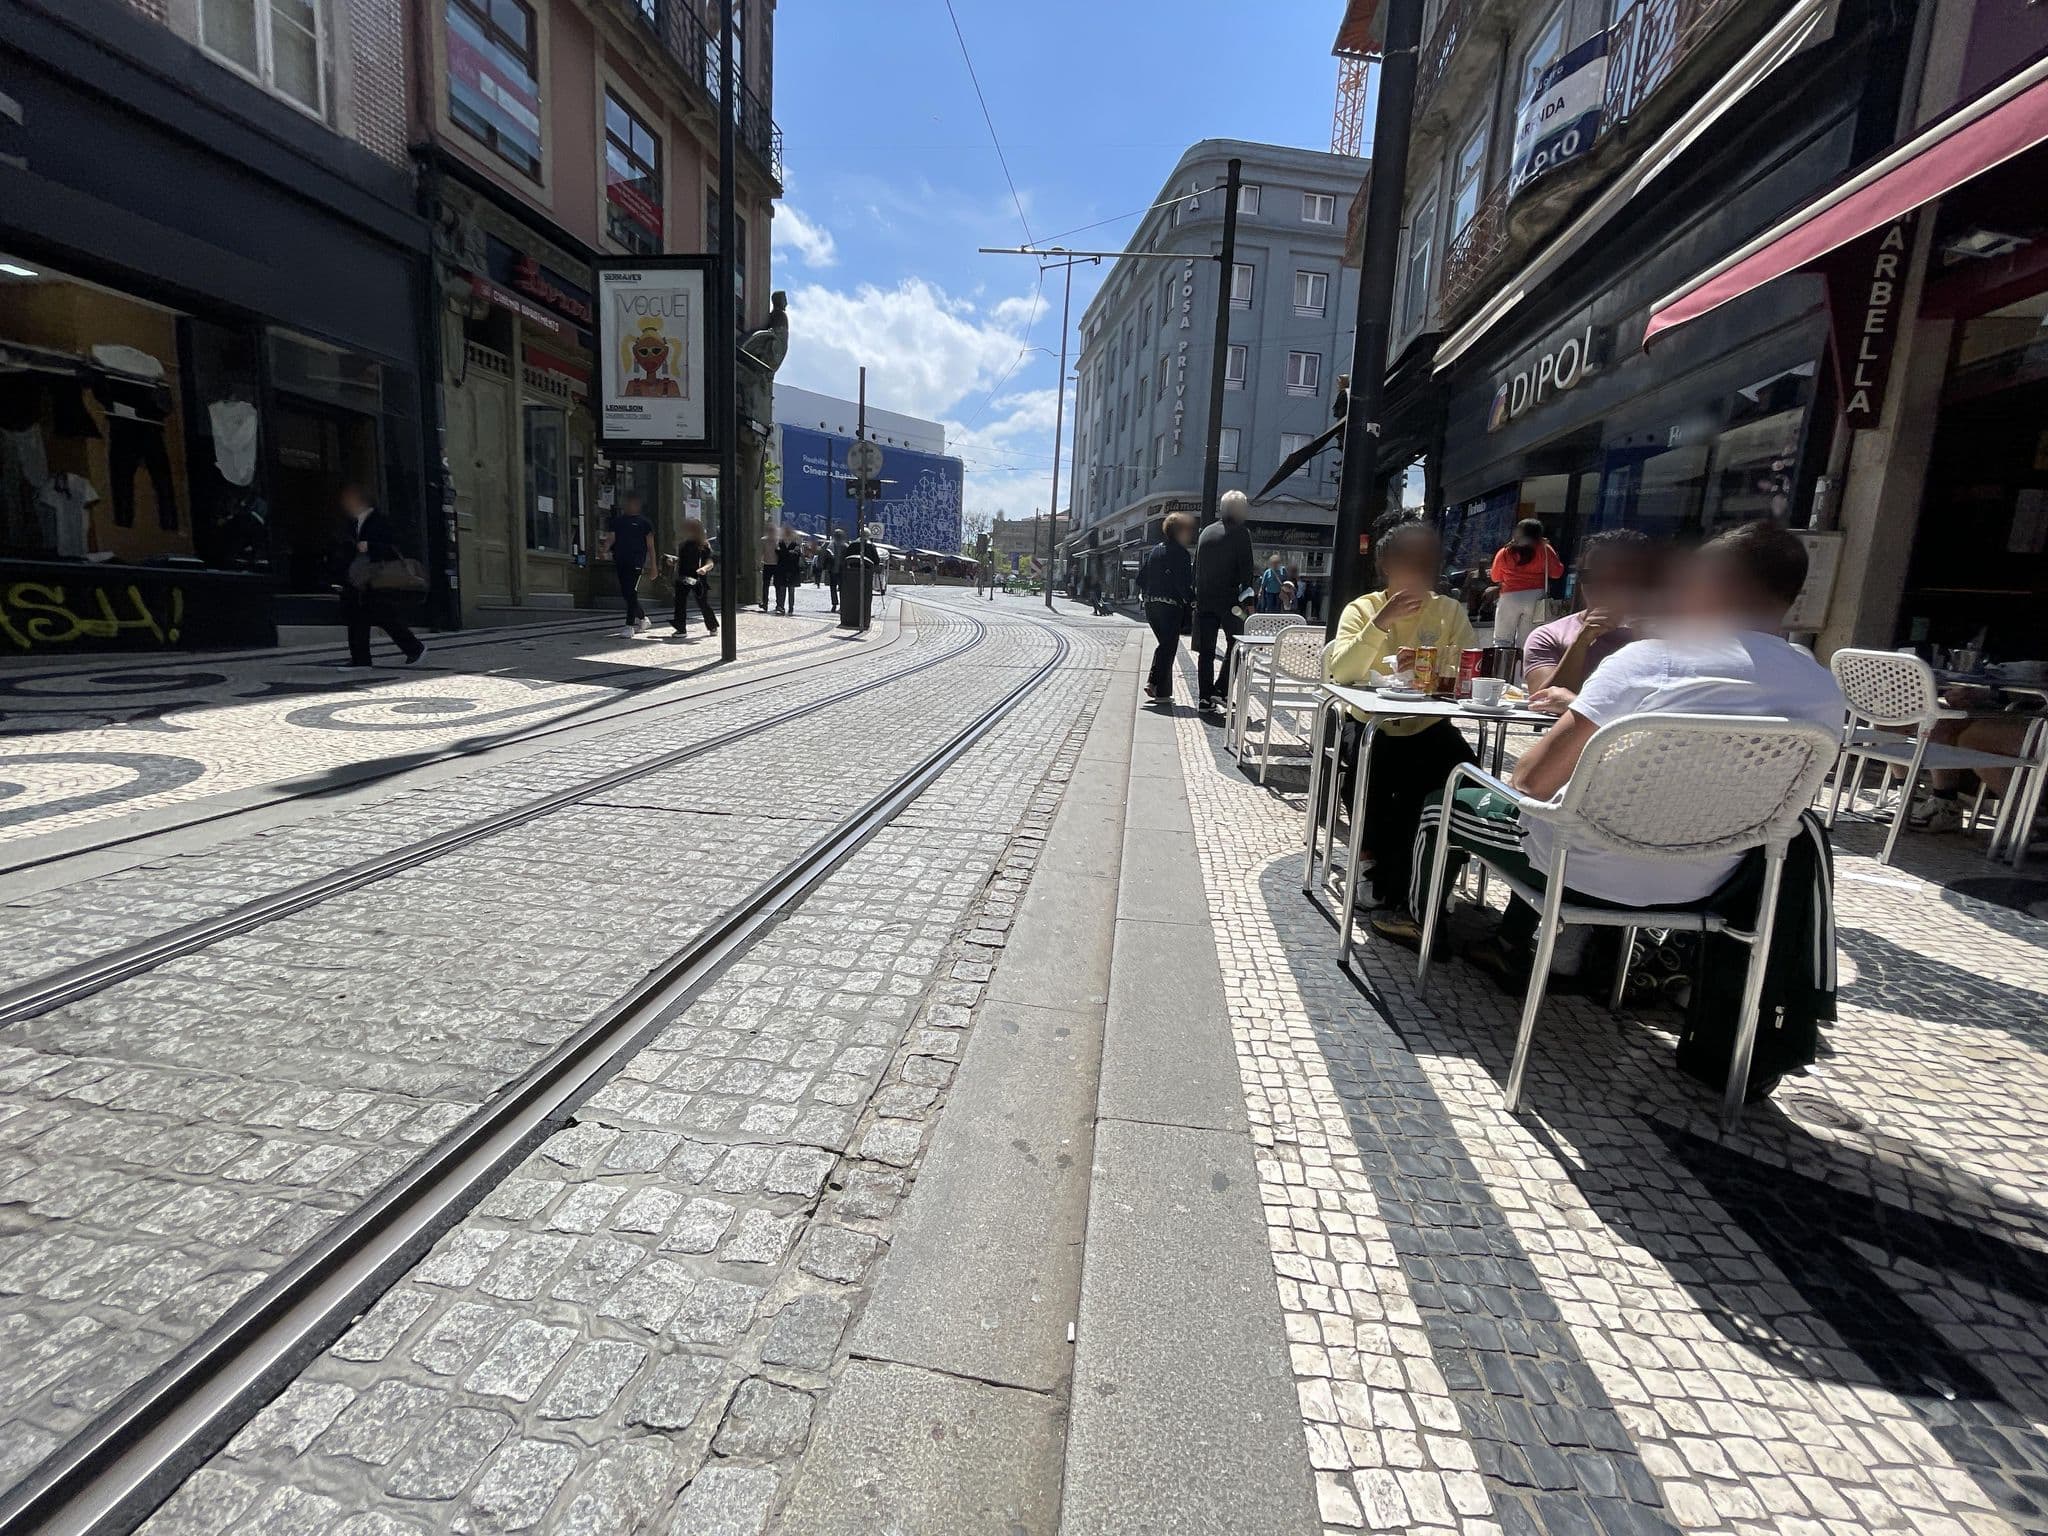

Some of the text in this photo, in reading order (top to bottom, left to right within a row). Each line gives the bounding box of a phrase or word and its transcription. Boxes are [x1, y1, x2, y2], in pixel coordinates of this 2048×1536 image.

[1189, 182, 1199, 211] LA
[618, 294, 687, 318] VOGUE
[1846, 212, 1912, 414] ARBELLA
[1172, 341, 1188, 456] PRIVATTI
[1510, 325, 1594, 418] DIPOL
[605, 404, 643, 412] LEONILSON
